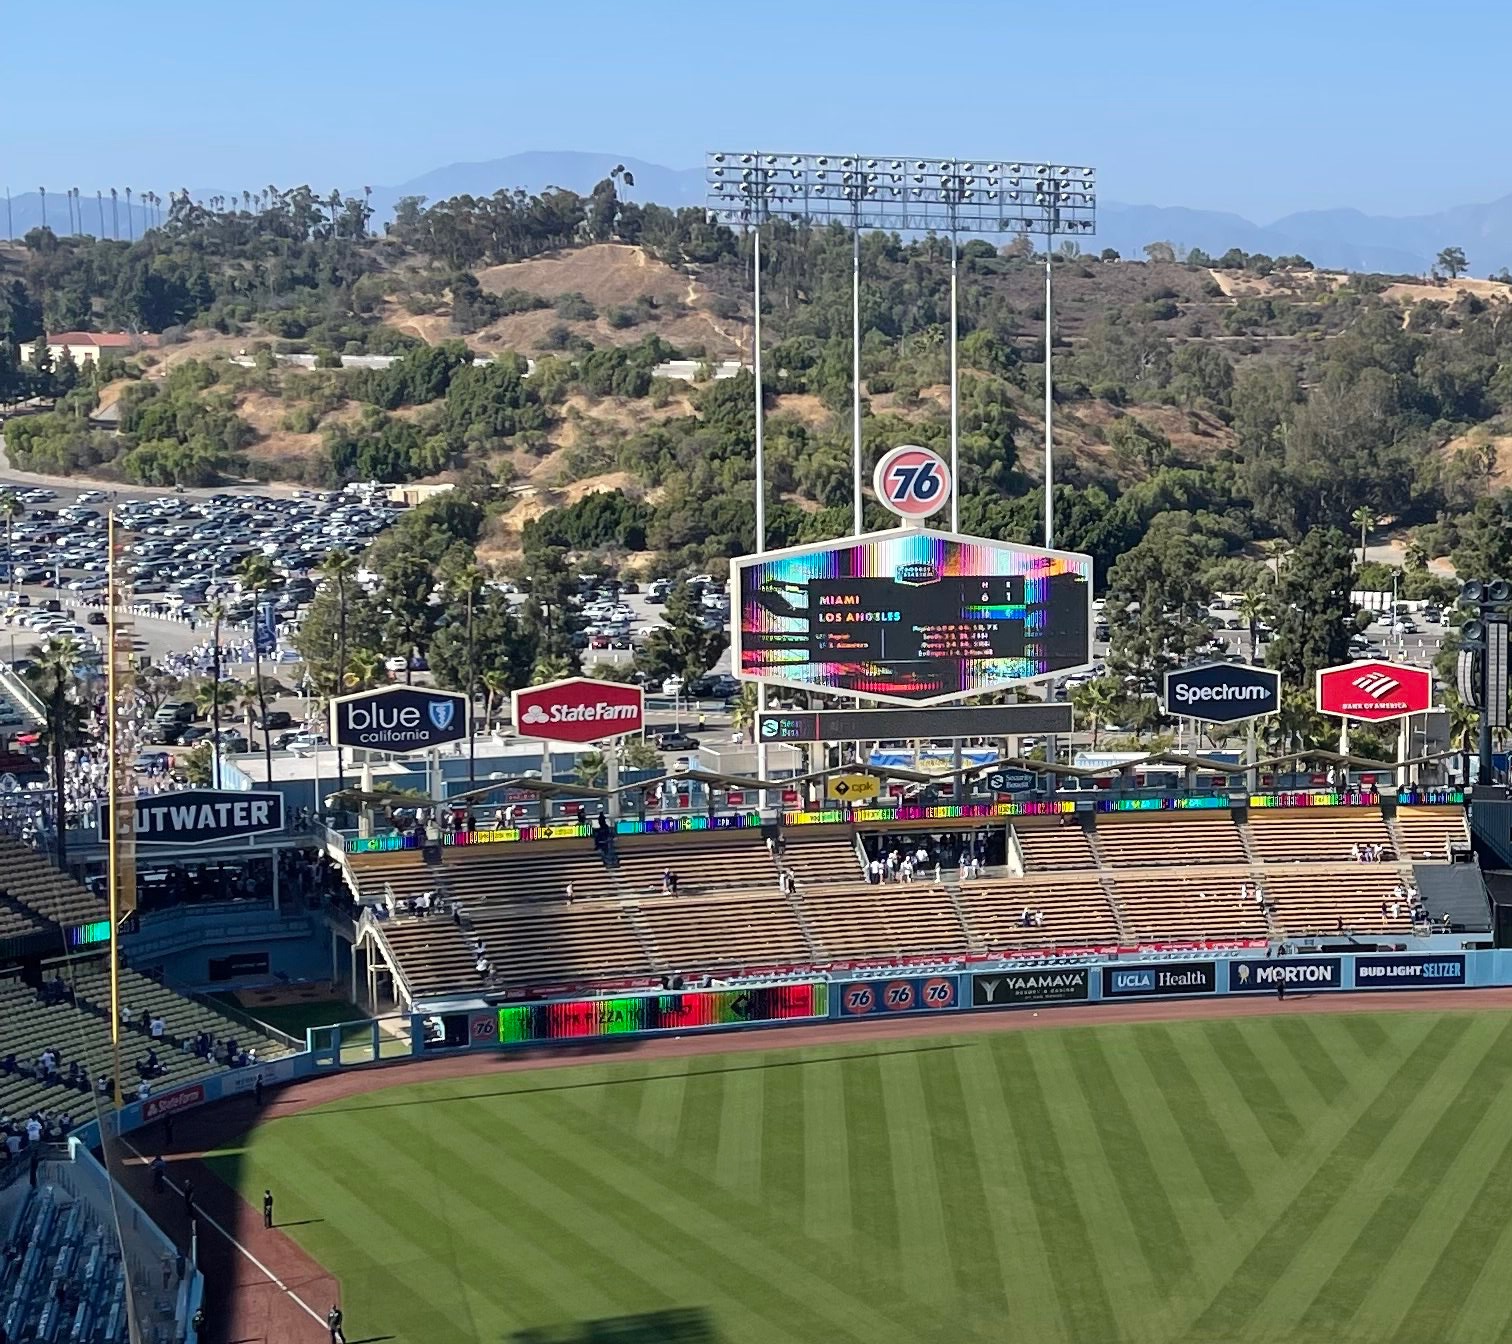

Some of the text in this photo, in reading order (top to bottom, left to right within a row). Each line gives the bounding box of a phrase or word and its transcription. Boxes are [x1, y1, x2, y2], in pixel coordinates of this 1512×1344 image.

[889, 460, 942, 501] 76
[819, 594, 861, 606] MIAMI
[818, 611, 842, 623] LOS
[1175, 683, 1265, 704] Spectrum
[348, 702, 421, 731] blue
[359, 727, 430, 744] california
[851, 781, 874, 793] cpk
[1256, 965, 1332, 983] MORTON
[1359, 962, 1461, 977] BUD LIGHT SELTZER
[1117, 974, 1151, 988] UCLA
[1158, 970, 1207, 987] Health
[849, 991, 871, 1007] 76
[888, 987, 910, 1003] 76
[927, 984, 949, 1001] 76
[474, 1020, 494, 1034] 76
